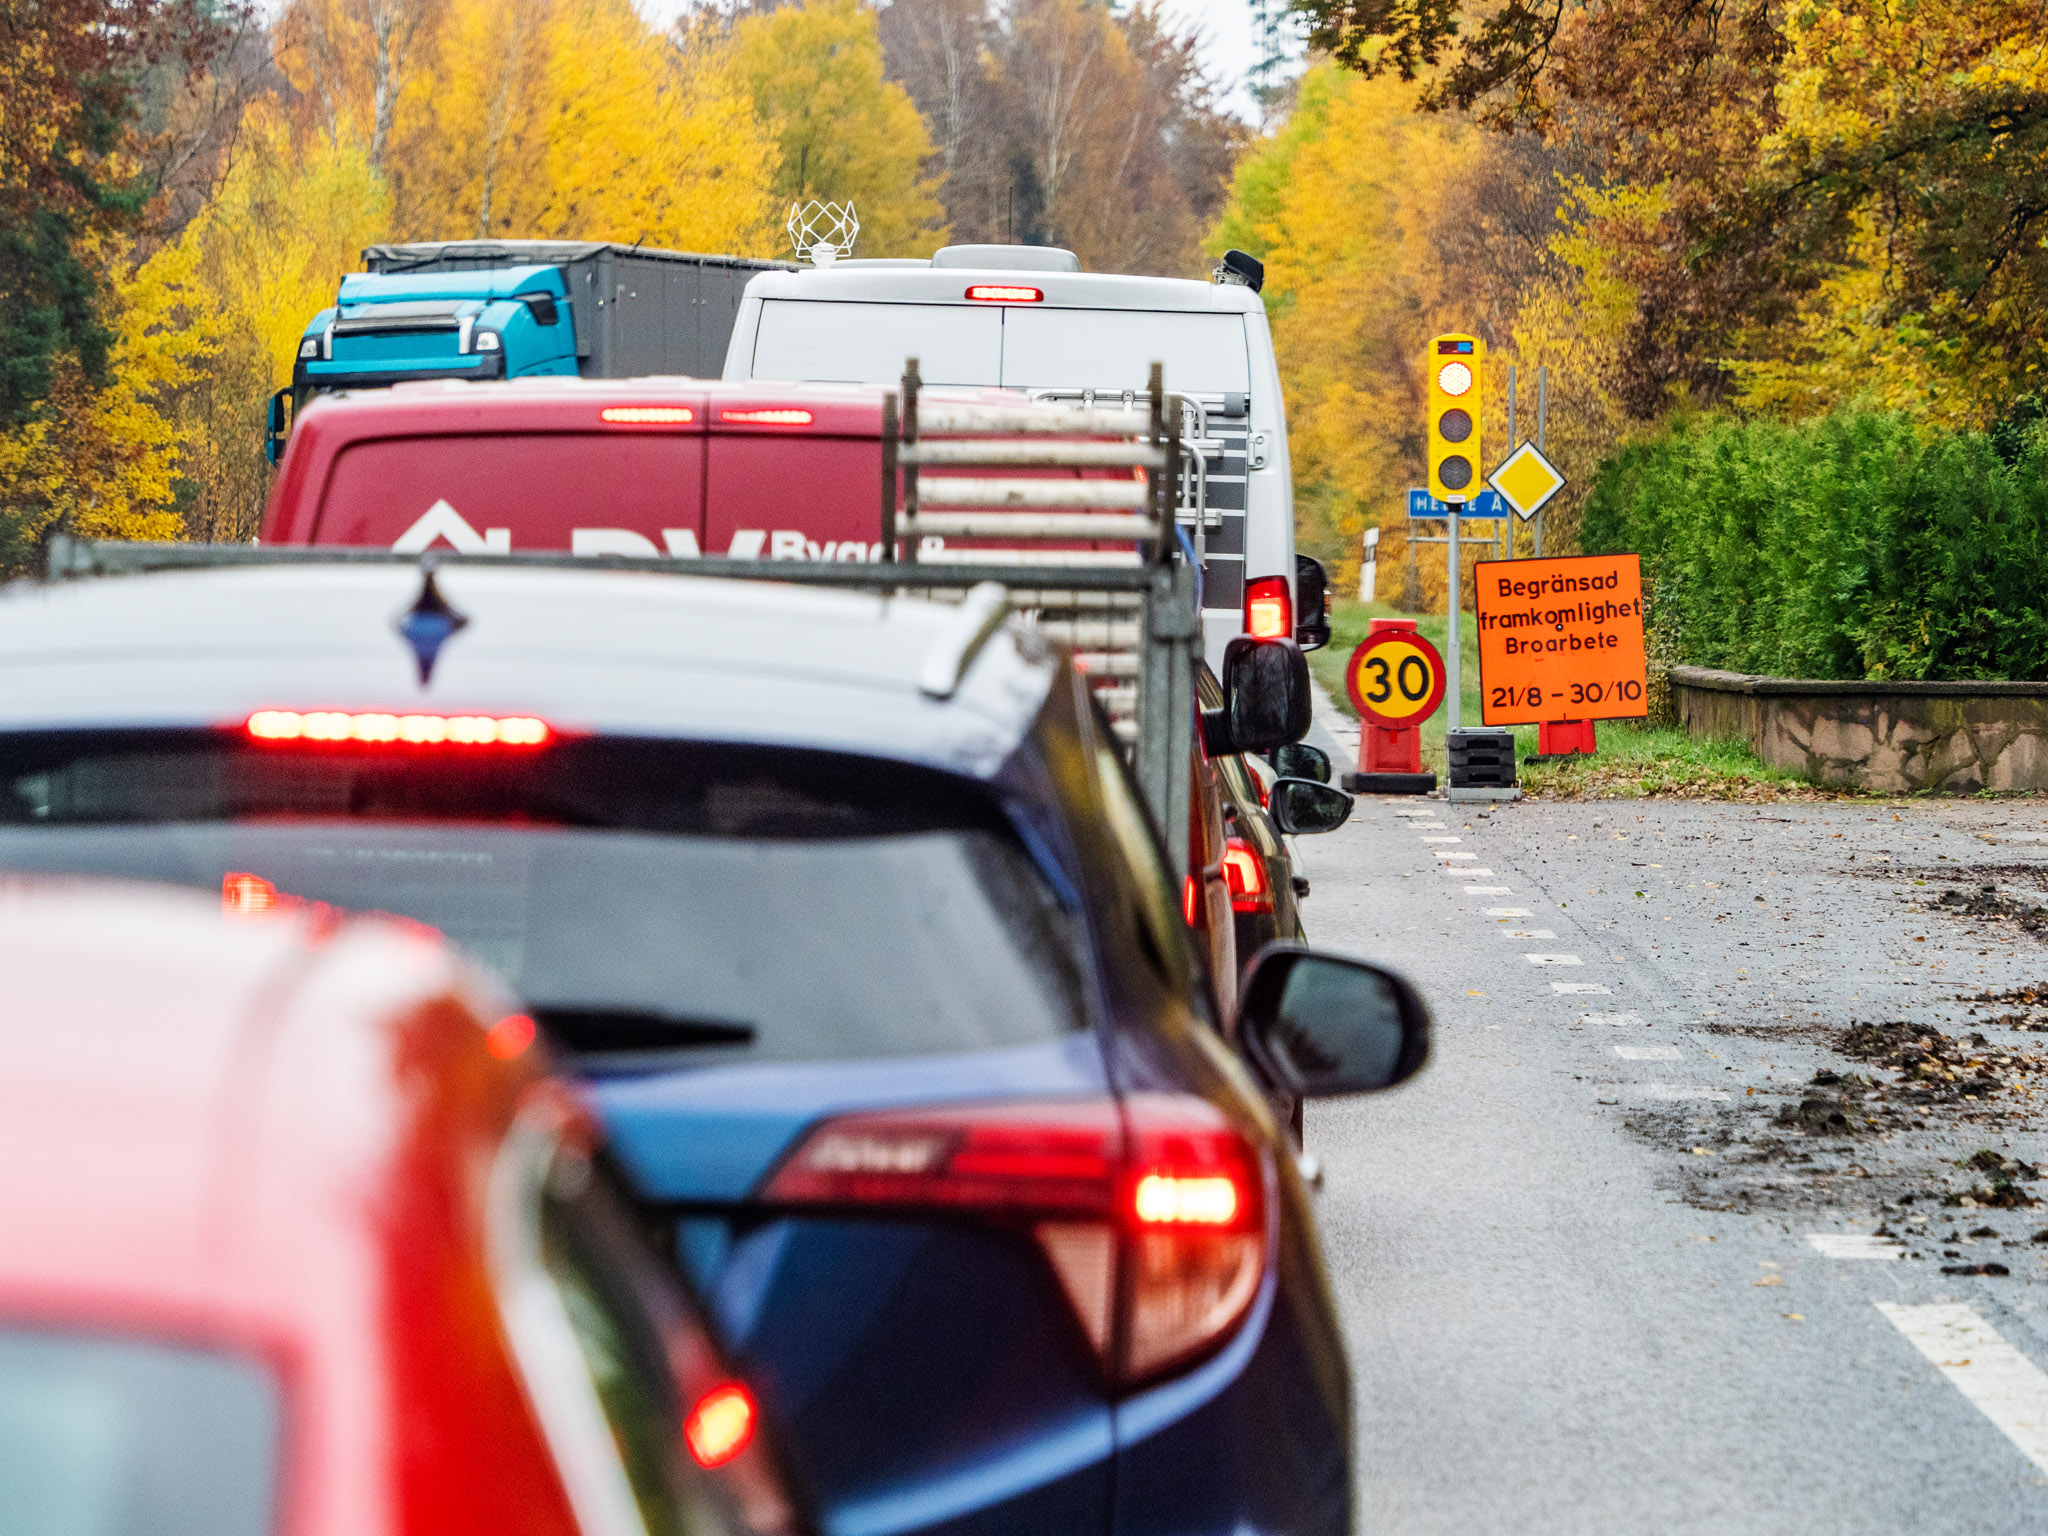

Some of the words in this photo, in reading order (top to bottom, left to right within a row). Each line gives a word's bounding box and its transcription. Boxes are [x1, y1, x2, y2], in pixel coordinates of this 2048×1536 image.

[1416, 496, 1477, 511] HEE
[1498, 571, 1618, 599] Begränsad
[1480, 598, 1641, 630] framkomlighet
[1506, 632, 1618, 655] Broarbete
[1365, 655, 1430, 703] 30
[1492, 687, 1542, 708] 21/8
[1570, 680, 1642, 704] 30/10
